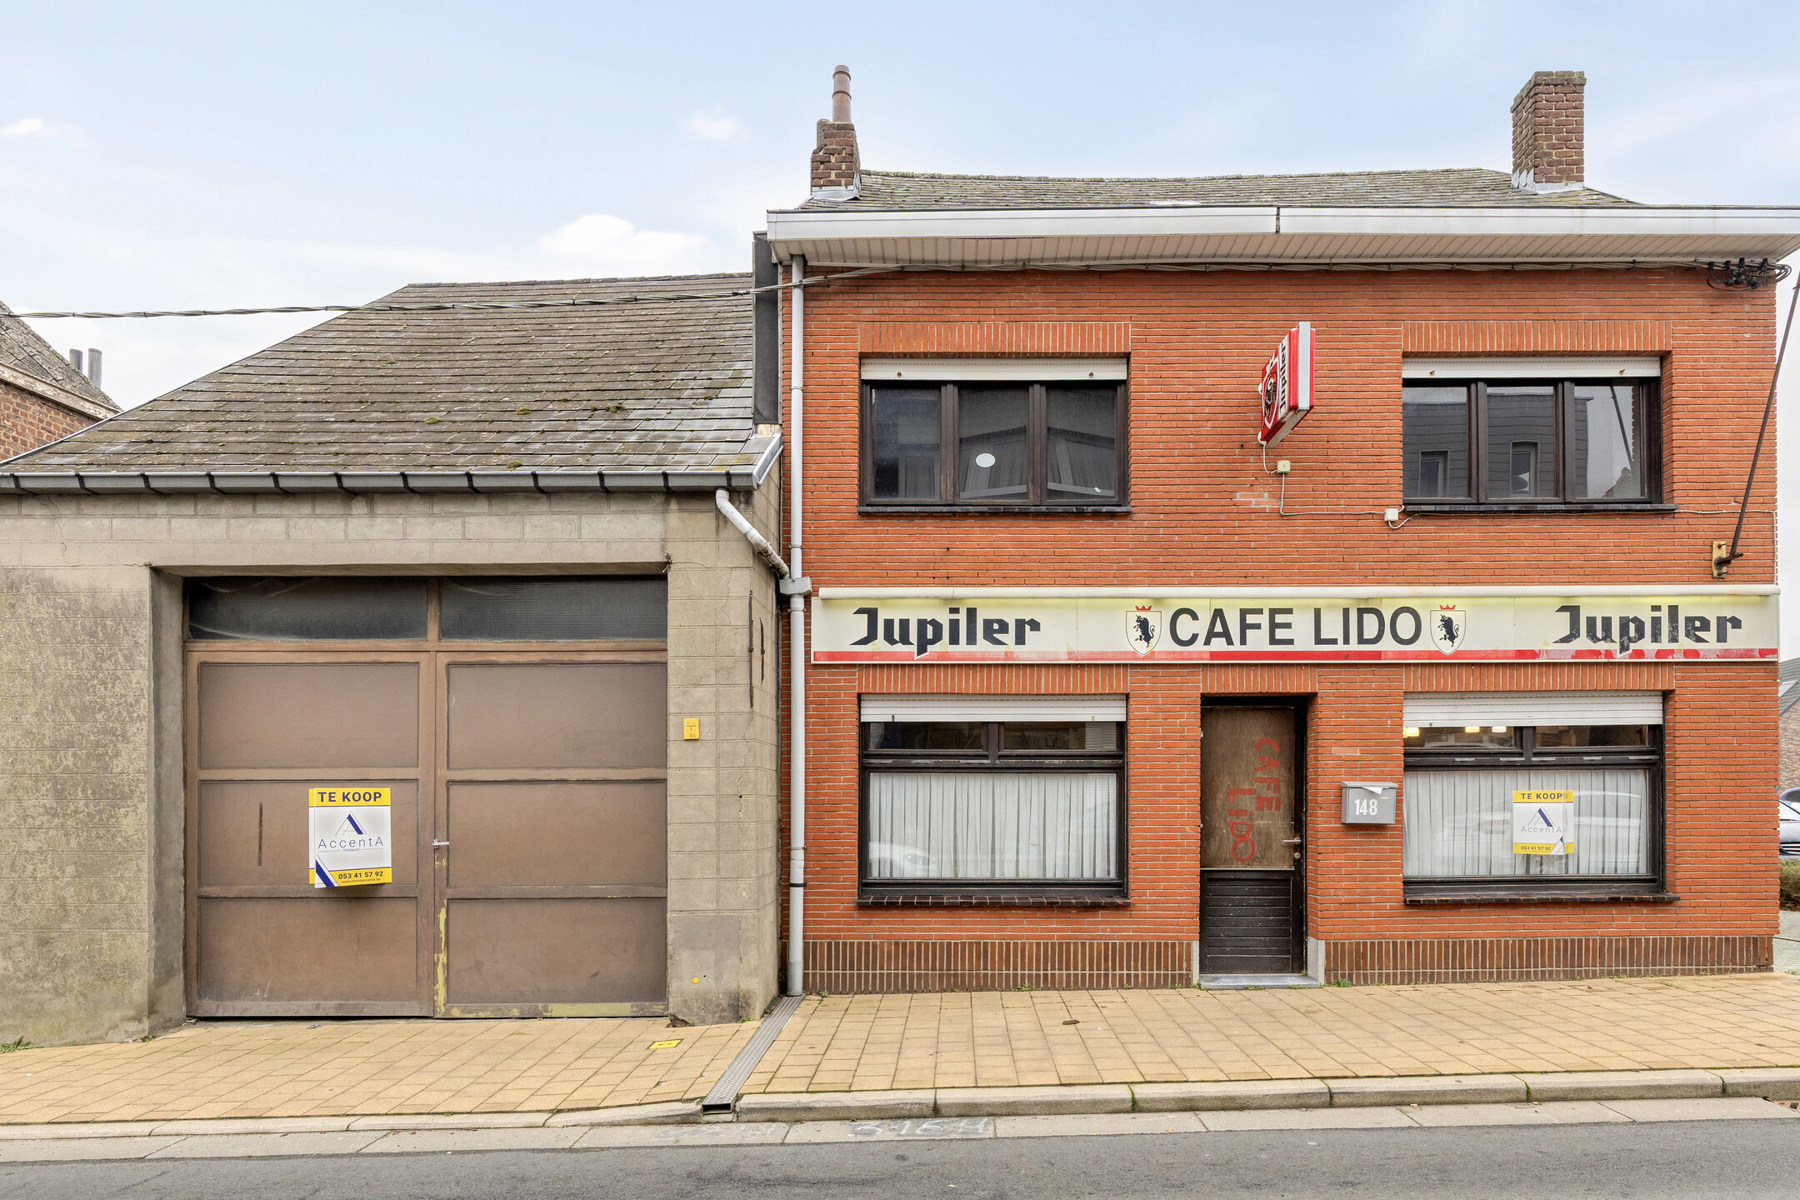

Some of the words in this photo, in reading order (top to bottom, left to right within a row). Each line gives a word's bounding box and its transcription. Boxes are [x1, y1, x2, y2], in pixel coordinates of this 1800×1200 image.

[850, 607, 1041, 657] Jupiler
[1169, 607, 1294, 647] CAFE
[1313, 606, 1422, 646] LIDO
[1552, 604, 1742, 655] Jupiler
[1255, 738, 1281, 812] CAFE
[318, 792, 336, 802] TE
[342, 791, 382, 802] KOOP
[1354, 798, 1378, 816] 148
[318, 836, 384, 849] AccentA
